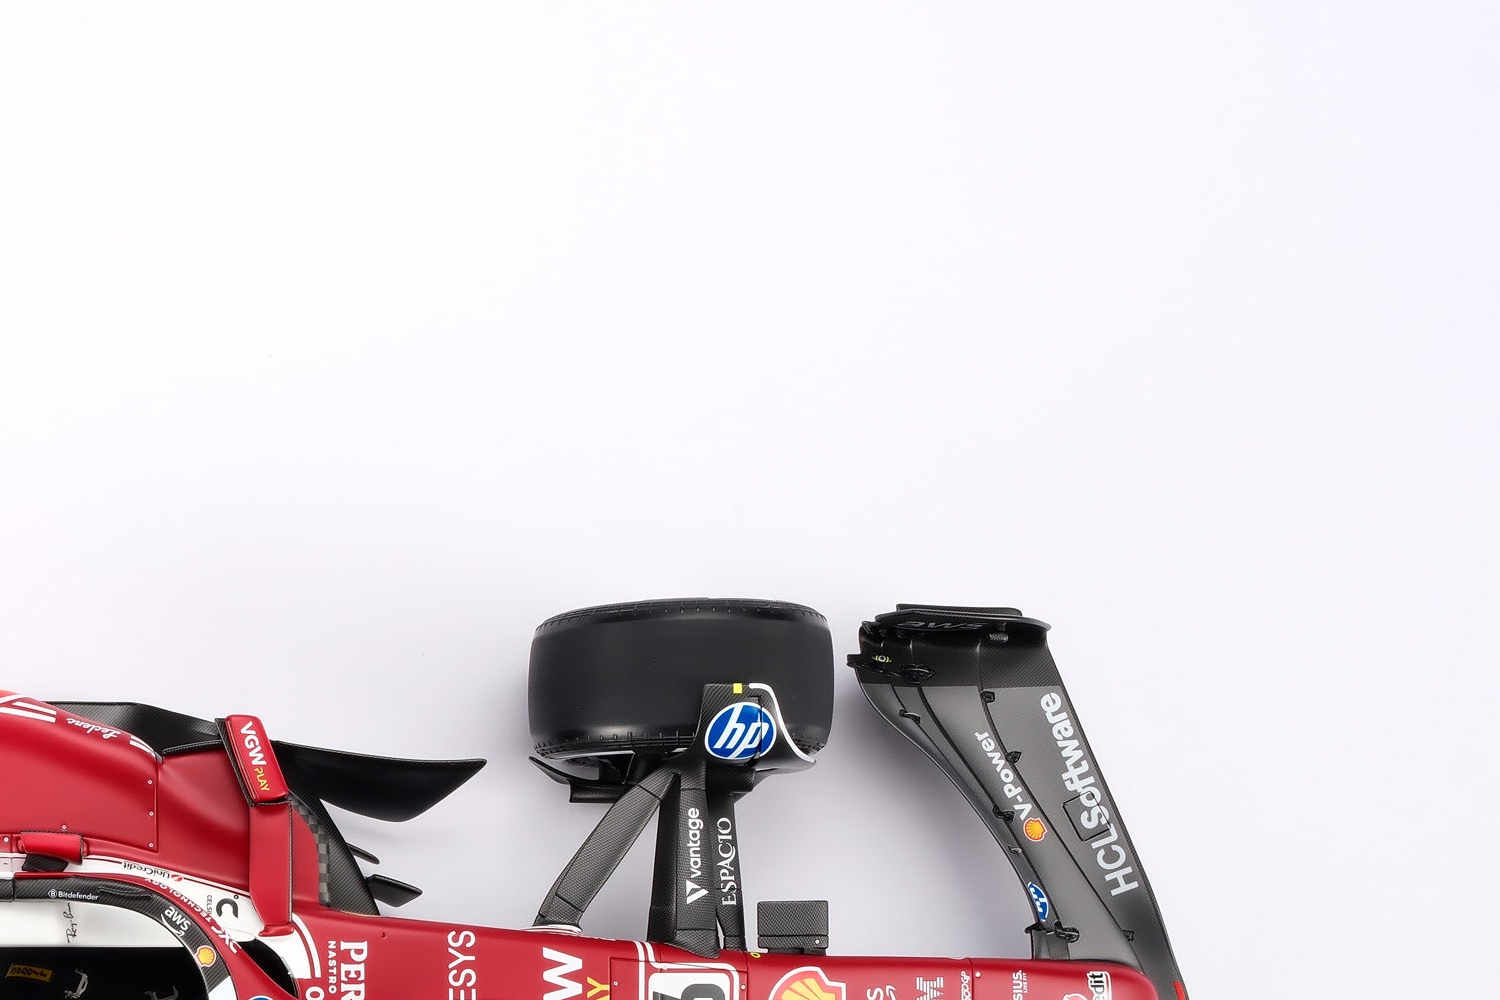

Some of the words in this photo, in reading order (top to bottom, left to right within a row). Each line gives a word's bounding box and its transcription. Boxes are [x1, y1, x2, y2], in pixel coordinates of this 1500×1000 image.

[66, 718, 121, 740] Leclerc
[240, 721, 266, 766] VGW
[254, 766, 270, 792] PLAY
[712, 703, 770, 759] hp
[974, 731, 1033, 820] V-Power
[1040, 692, 1139, 897] HCLSoftware
[123, 861, 170, 879] UniCredit
[687, 807, 703, 878] vantage
[716, 817, 737, 905] ESPACIO
[58, 890, 99, 900] Bitdefender
[145, 878, 212, 923] TECHNOLOGY
[165, 906, 191, 931] aws
[327, 940, 338, 994] NASTRO
